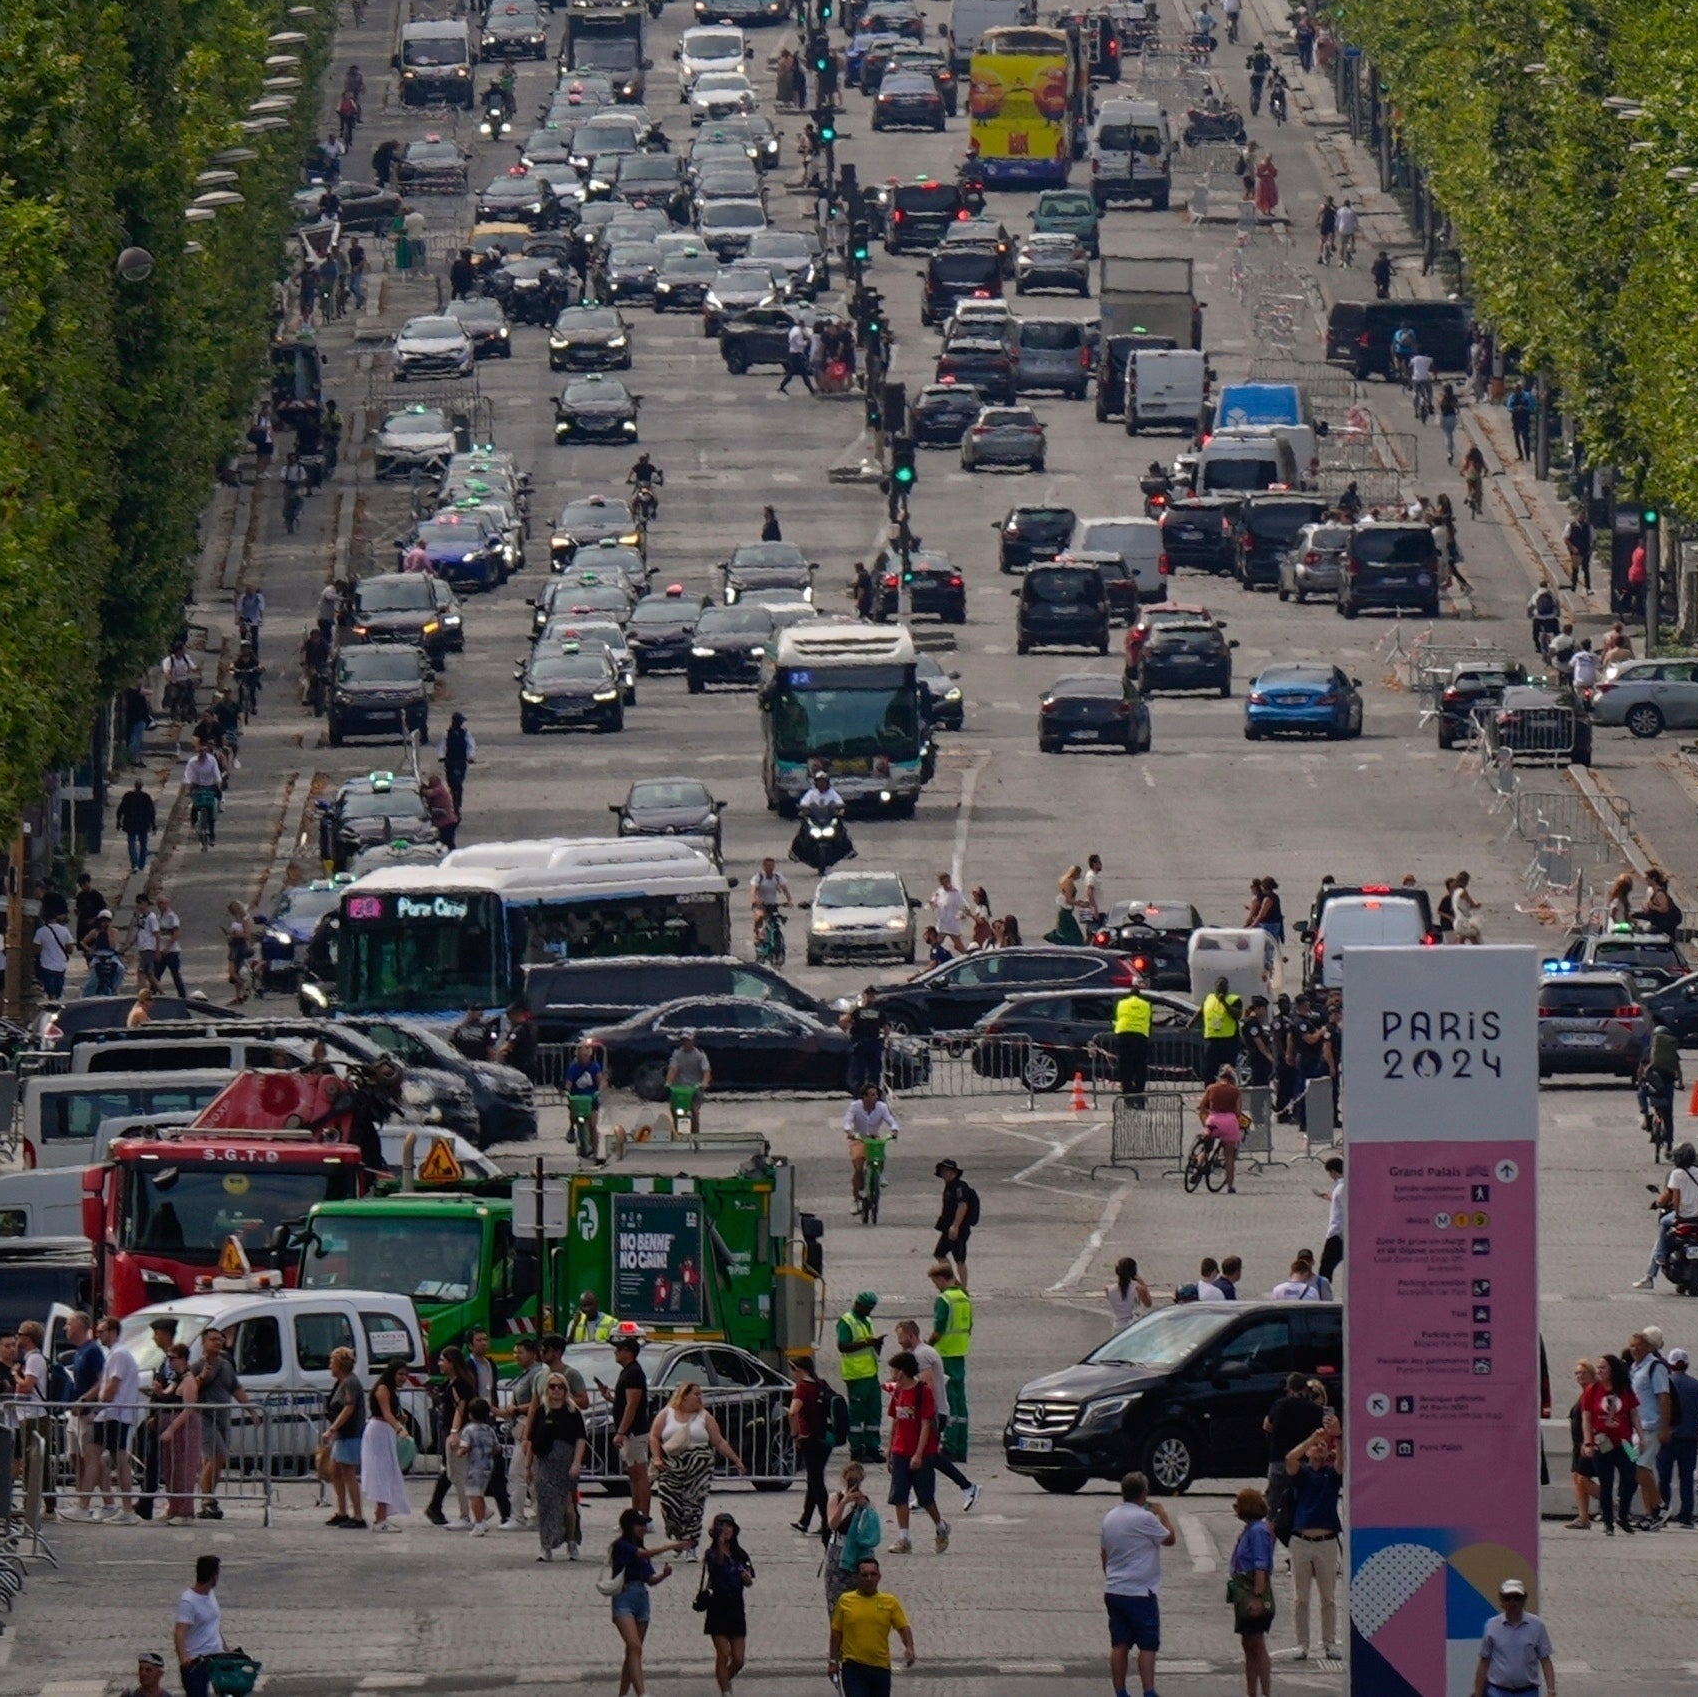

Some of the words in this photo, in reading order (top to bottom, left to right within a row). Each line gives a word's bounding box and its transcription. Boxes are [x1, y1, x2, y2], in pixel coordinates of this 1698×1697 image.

[1384, 1048, 1501, 1078] 2024
[1390, 1167, 1423, 1177] Grand
[1428, 1167, 1460, 1177] Palais
[620, 1233, 636, 1251] NO
[637, 1233, 671, 1251] BENNE
[620, 1251, 637, 1269] NO
[638, 1251, 667, 1269] GAIN!
